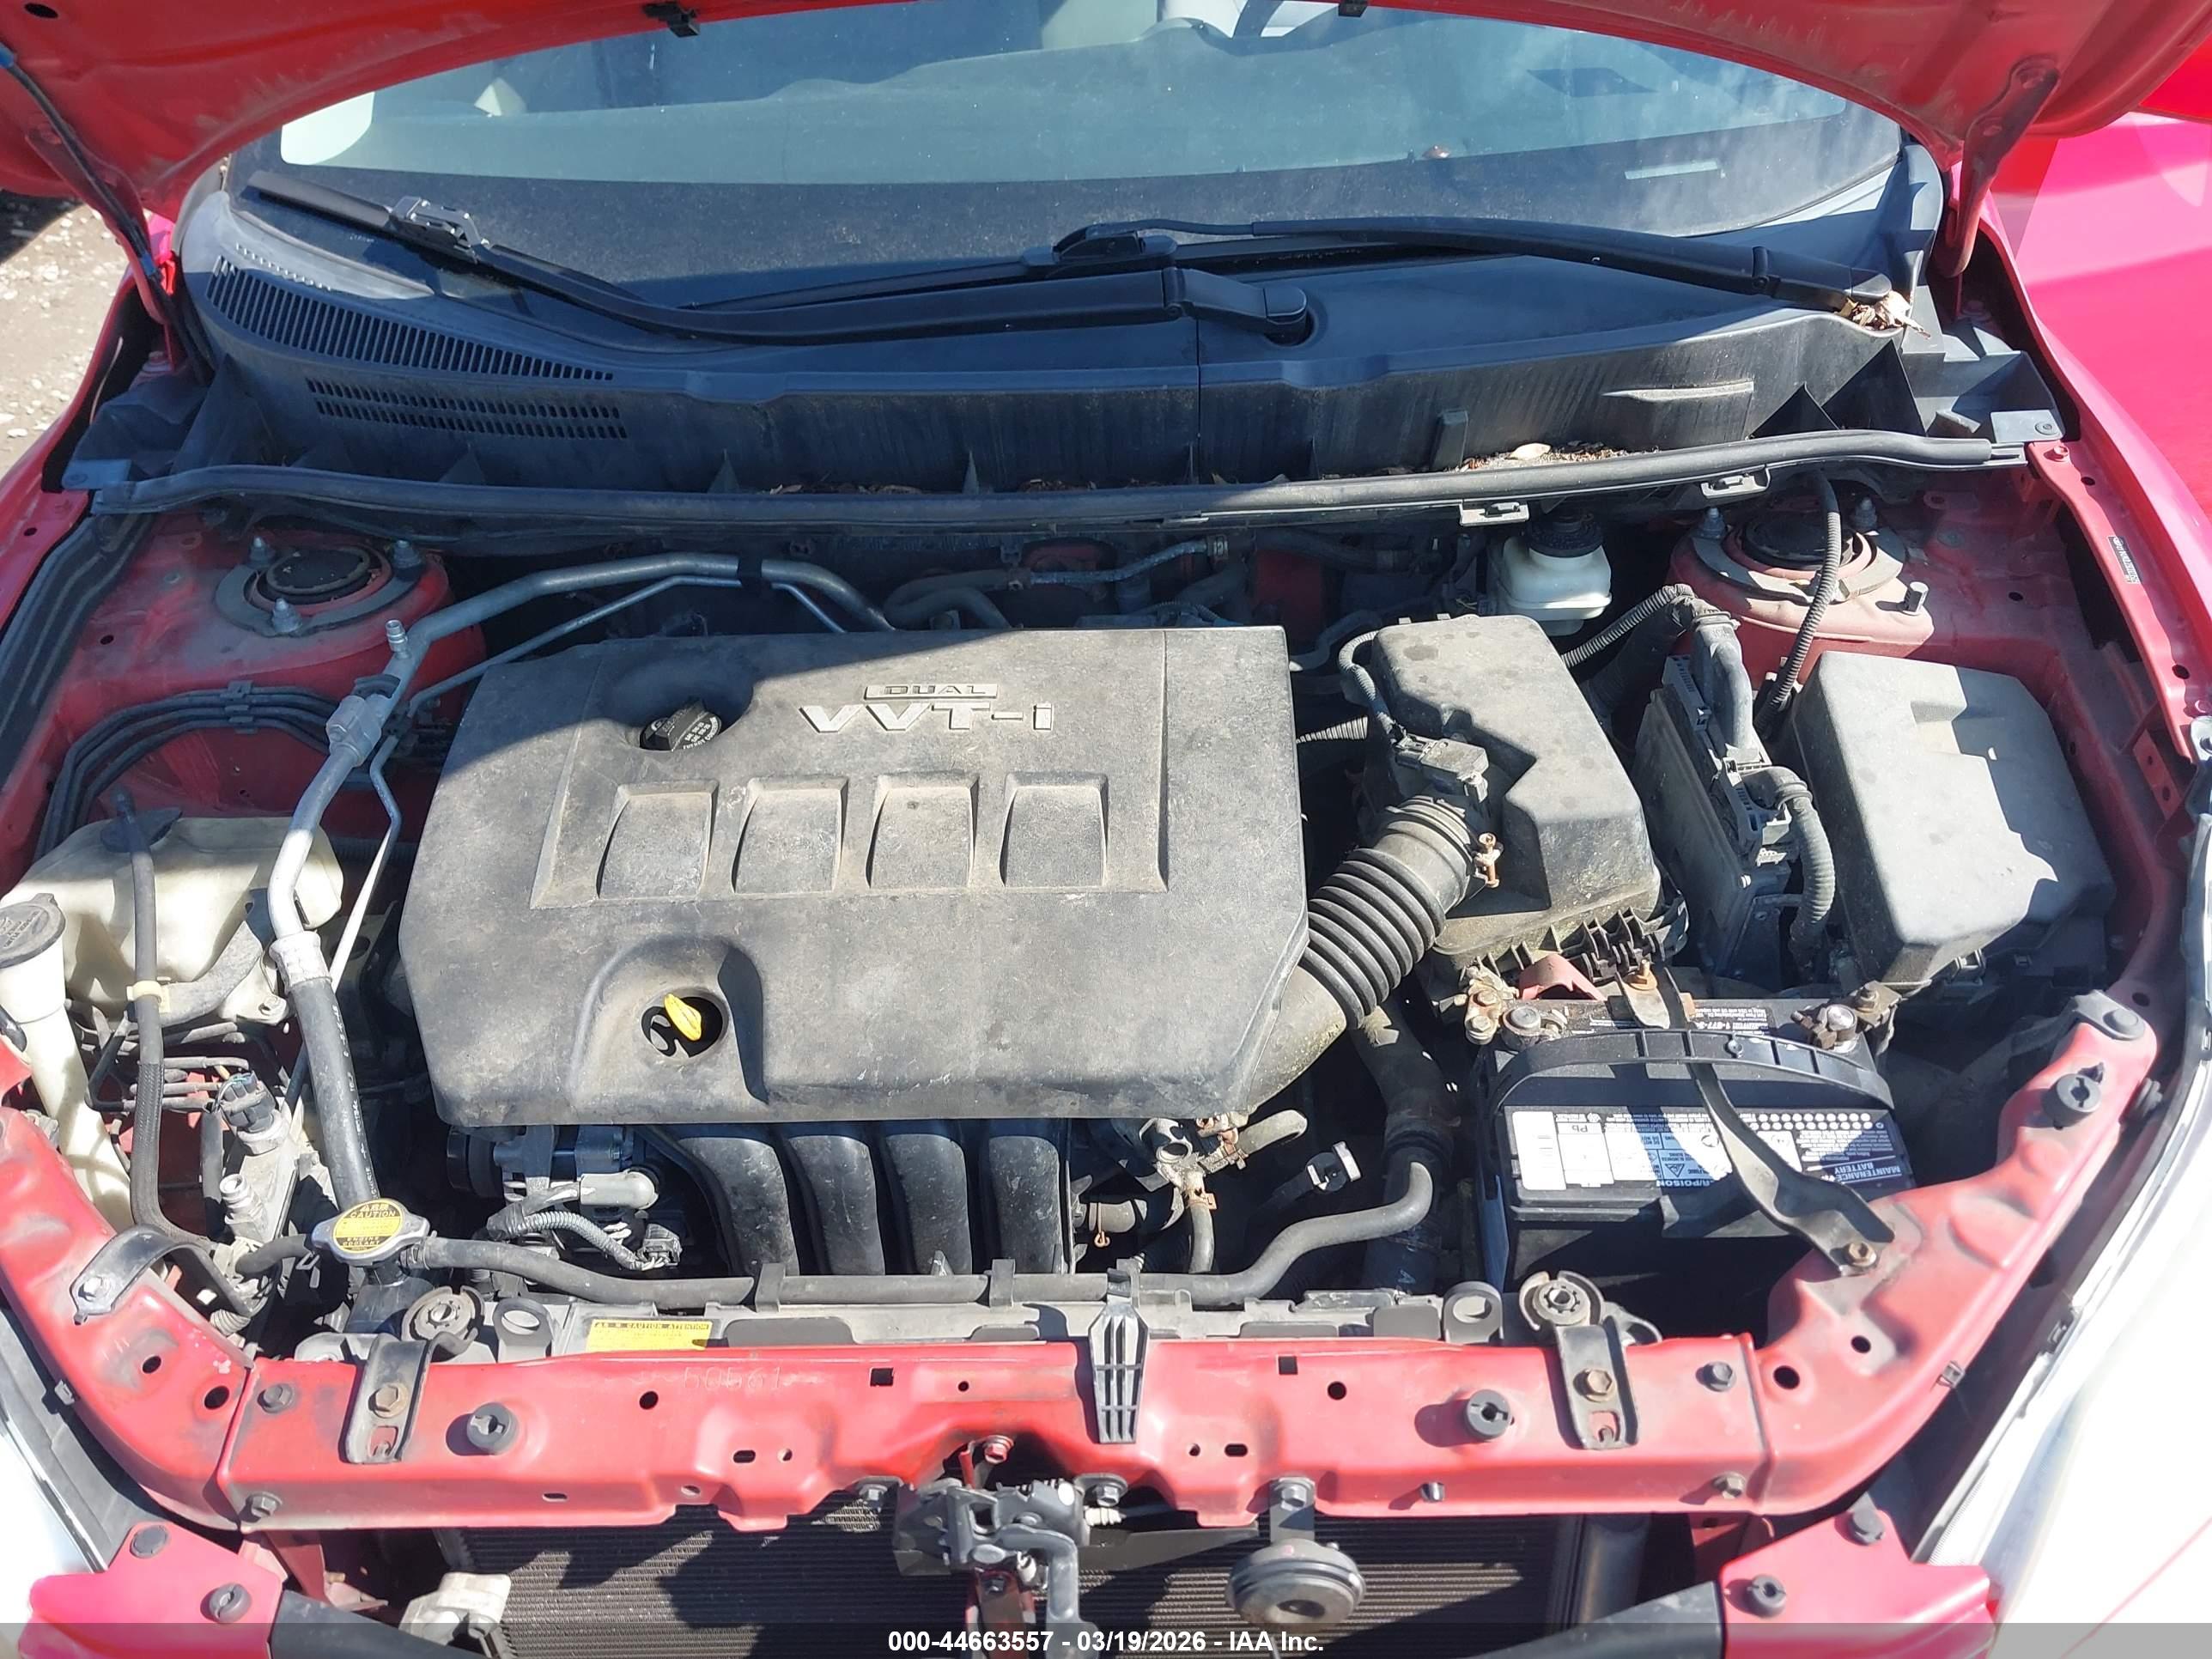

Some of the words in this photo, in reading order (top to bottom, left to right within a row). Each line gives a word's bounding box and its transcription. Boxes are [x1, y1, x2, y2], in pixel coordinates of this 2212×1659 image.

[884, 685, 988, 696] DUAL
[798, 701, 1054, 733] VVT-i
[1571, 1124, 1589, 1133] Pb
[1834, 1161, 1875, 1175] BATTERY
[1834, 1165, 1901, 1182] MAINTENANCE
[349, 1210, 397, 1218] CAUTION
